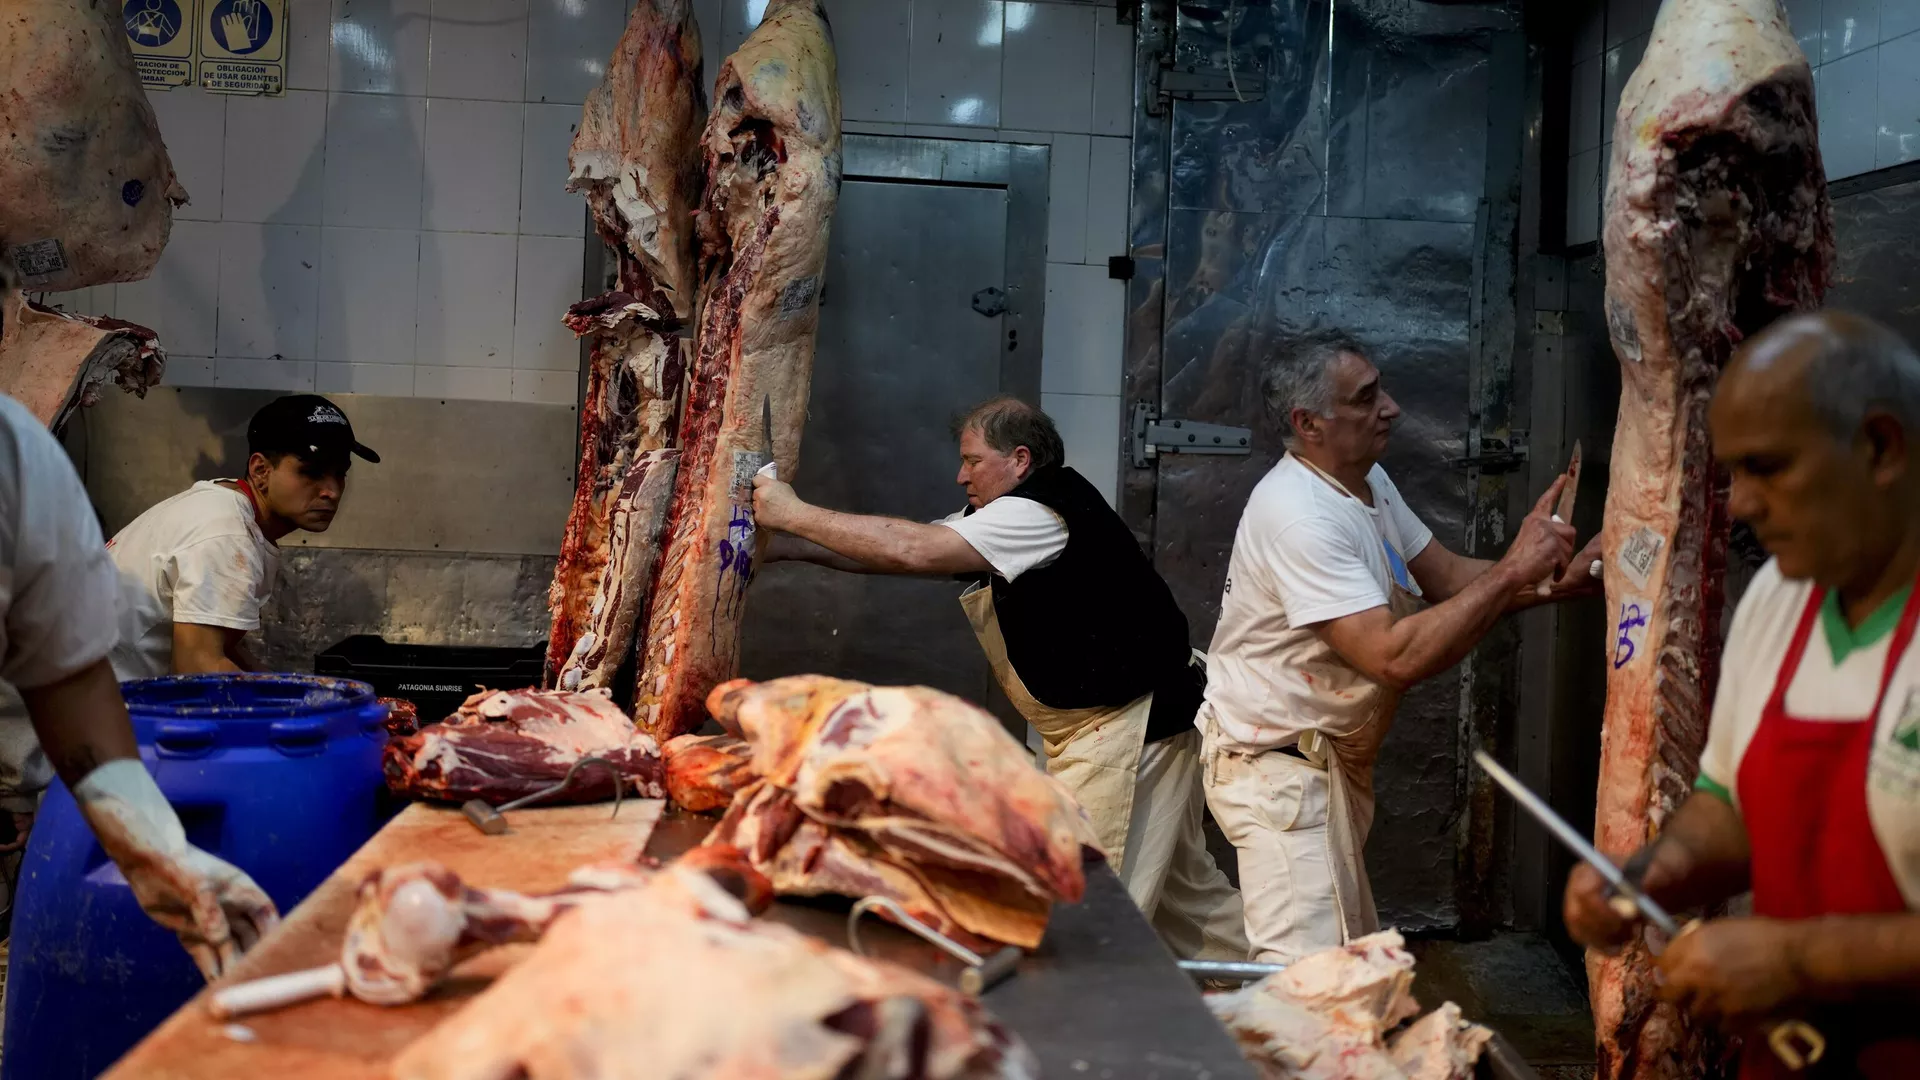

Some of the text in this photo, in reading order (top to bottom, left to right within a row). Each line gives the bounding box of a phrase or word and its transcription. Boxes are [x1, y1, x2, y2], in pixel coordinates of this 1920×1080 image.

[217, 65, 266, 73] OBLIGACION
[217, 72, 239, 80] USAR
[240, 74, 279, 82] GUANTES
[212, 80, 271, 90] DE SEGURIDAD
[435, 684, 463, 692] SUNRISE
